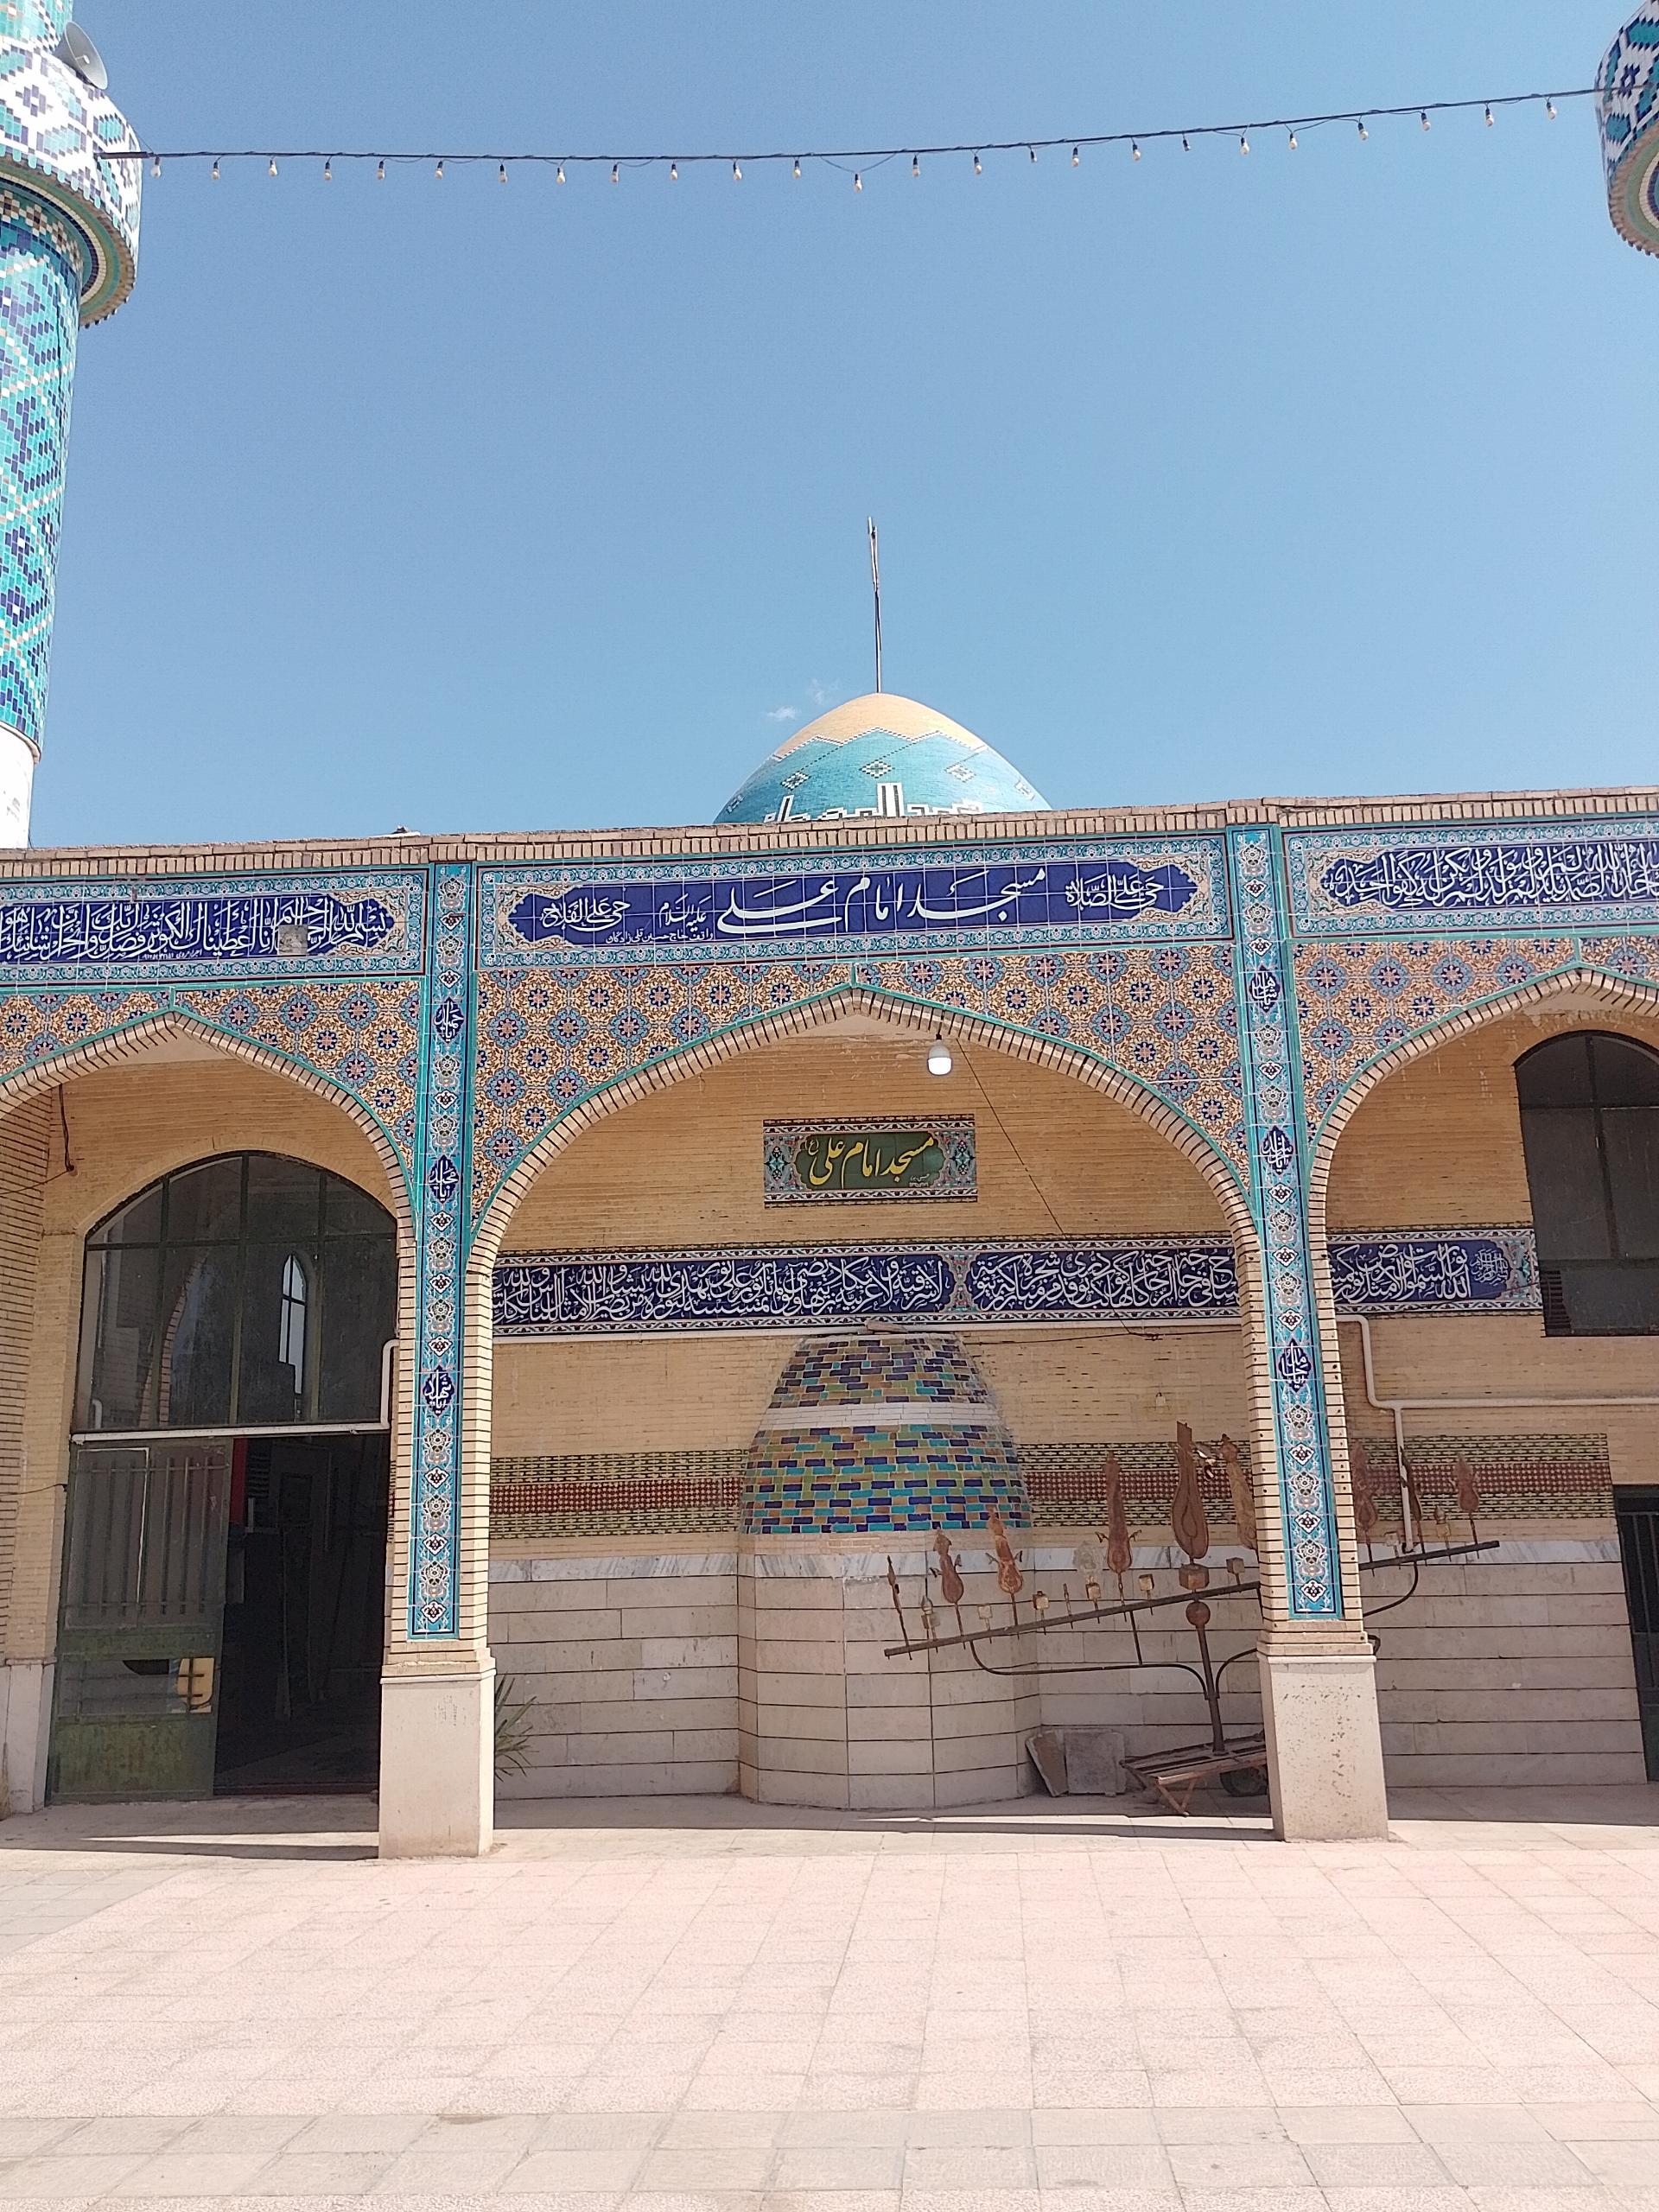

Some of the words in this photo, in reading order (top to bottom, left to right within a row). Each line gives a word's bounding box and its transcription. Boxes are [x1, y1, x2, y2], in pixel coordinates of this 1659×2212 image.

[845, 877, 904, 932] امام
[907, 868, 1046, 921] مسجد
[809, 1136, 847, 1186] علی
[841, 1138, 881, 1191] امام
[880, 1135, 935, 1183] مسجد
